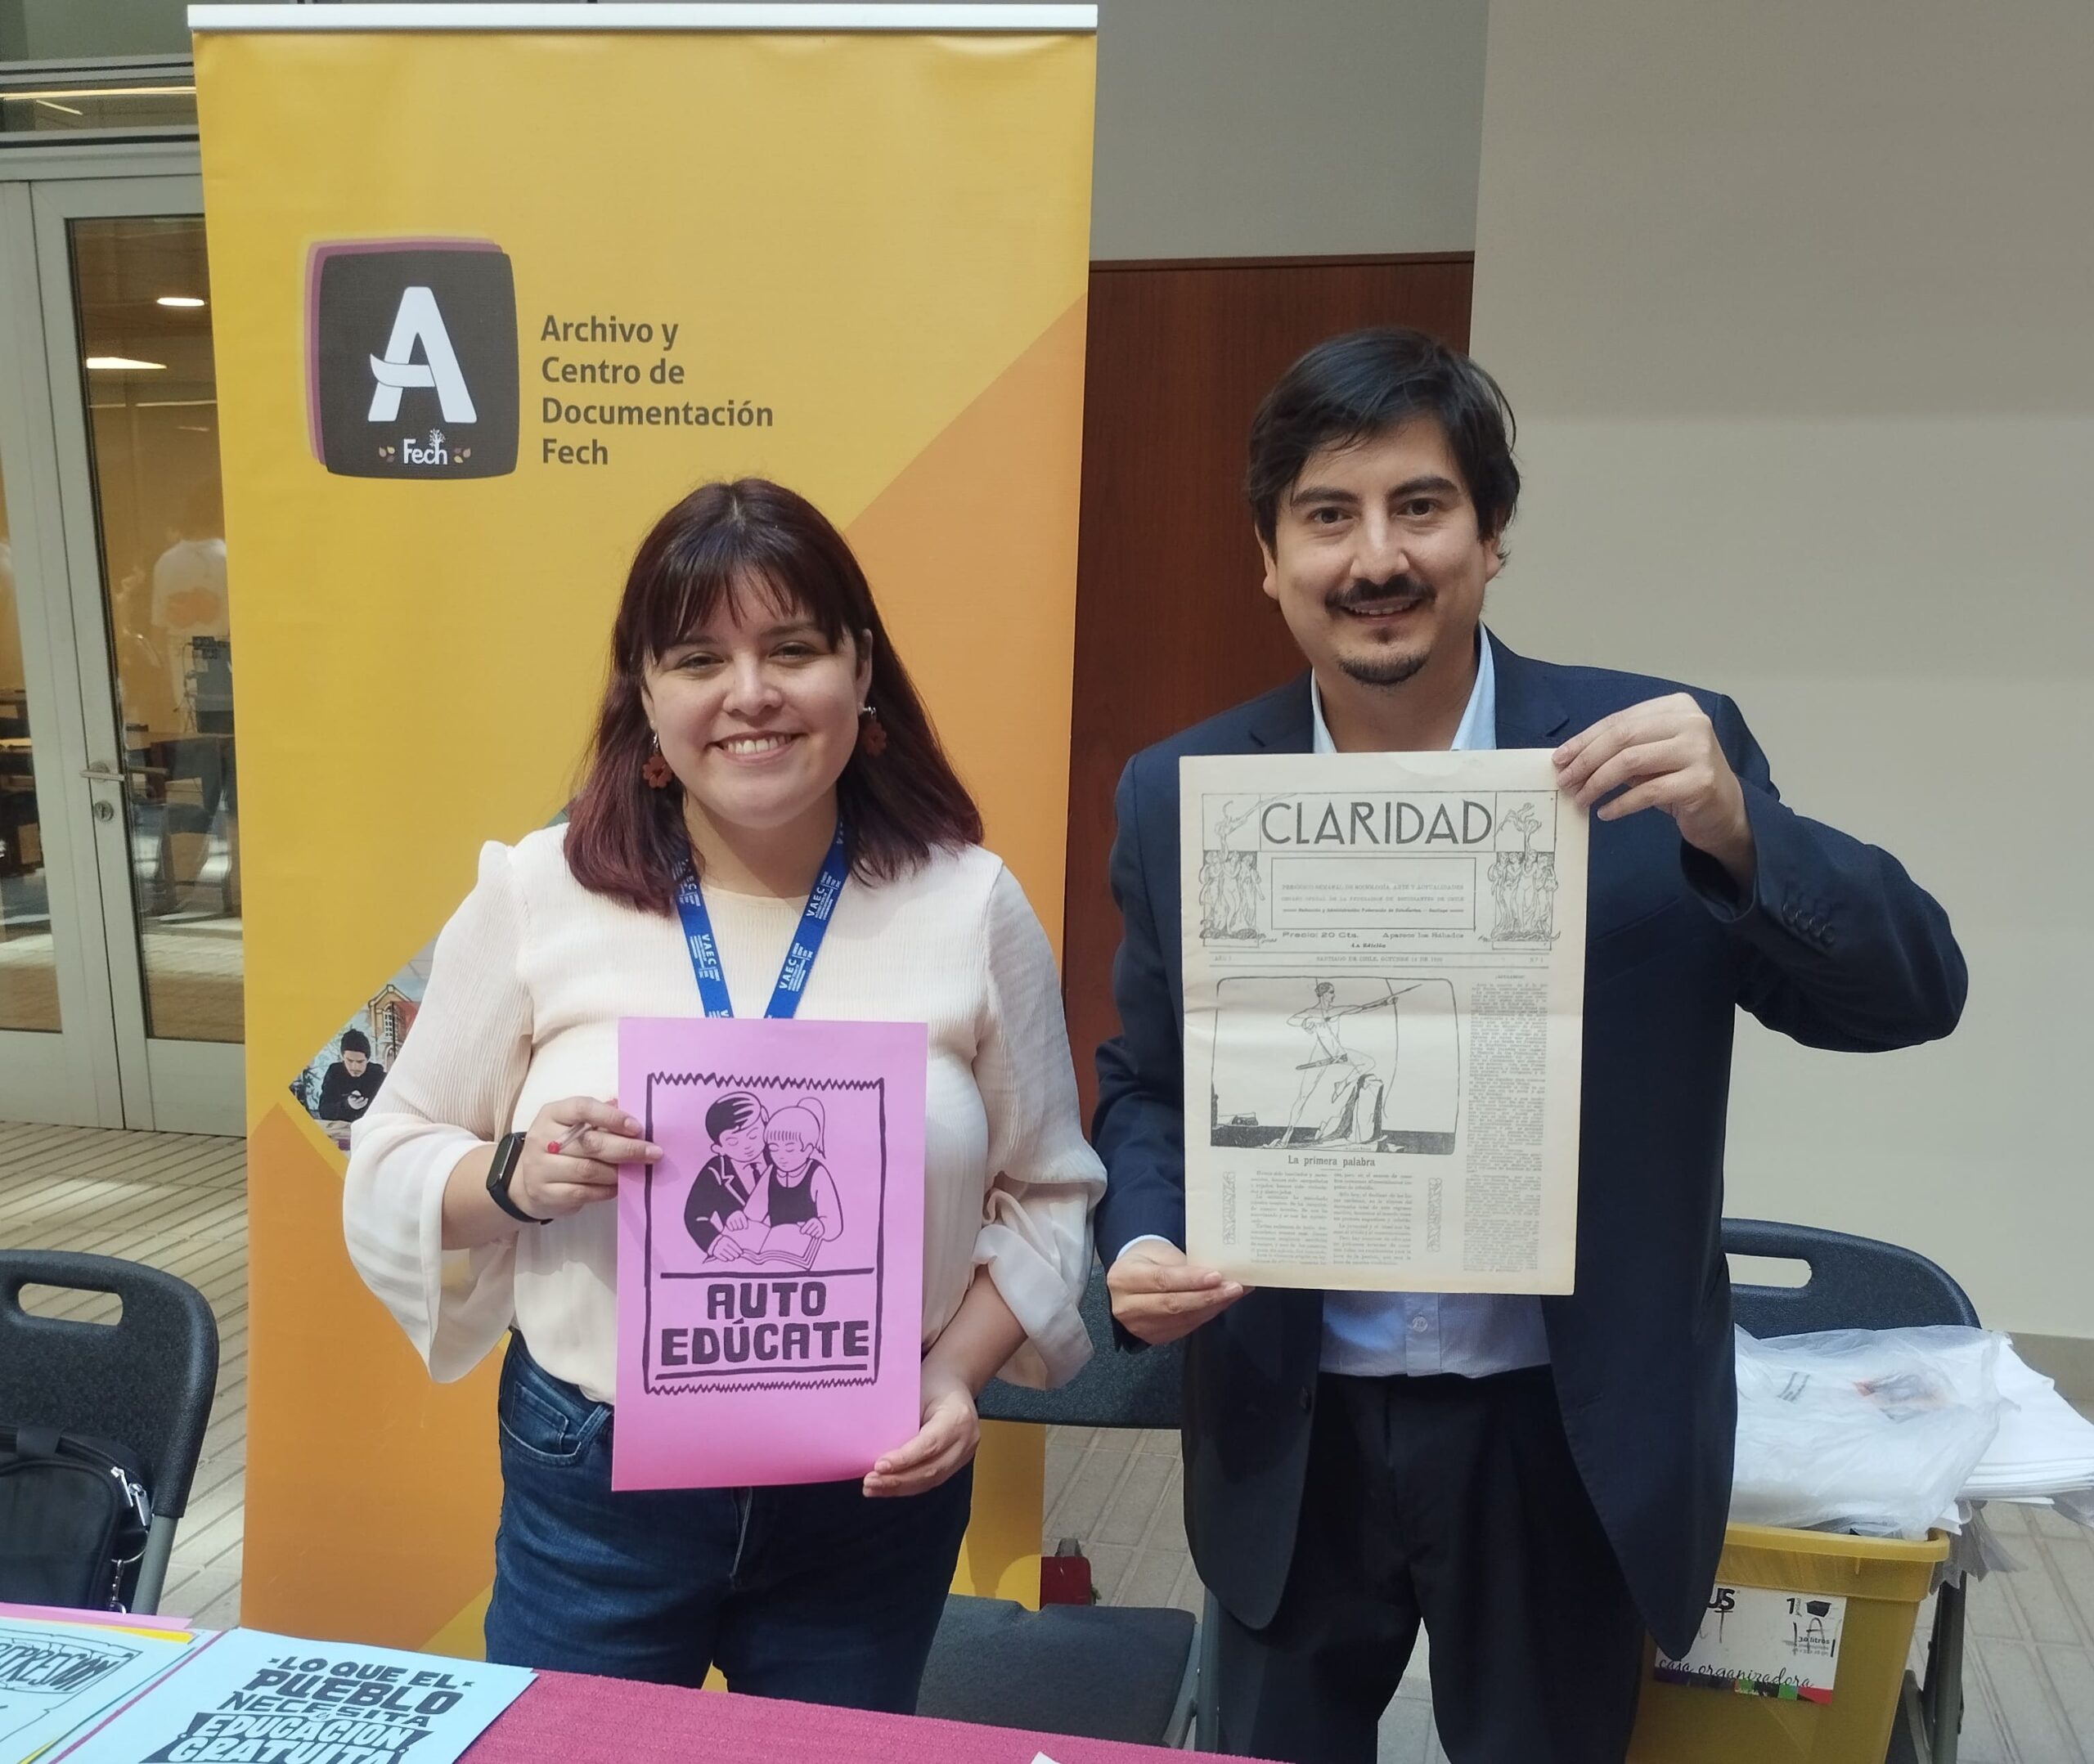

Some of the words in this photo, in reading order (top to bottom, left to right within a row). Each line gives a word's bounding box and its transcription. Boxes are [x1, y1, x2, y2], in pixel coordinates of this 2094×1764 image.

[541, 315, 654, 343] Archivo
[662, 323, 679, 352] y
[541, 357, 640, 384] Centro
[649, 357, 685, 384] de
[542, 397, 773, 426] Documentación
[403, 429, 448, 465] Fech
[542, 438, 609, 465] Fech
[1260, 800, 1493, 845] CLARIDAD
[806, 886, 826, 917] VAEC
[701, 934, 717, 965] VAEC
[779, 958, 797, 990] VAEC
[1288, 1155, 1299, 1165] La
[1304, 1156, 1338, 1167] primera
[1343, 1157, 1376, 1168] palabra
[707, 1281, 827, 1320] AUTO
[661, 1317, 870, 1367] EDÚCATE
[277, 1656, 327, 1672] LO
[330, 1661, 407, 1682] QUE
[410, 1671, 461, 1690] EL
[242, 1668, 465, 1715] PUEBLO
[217, 1690, 431, 1728] NECESITA
